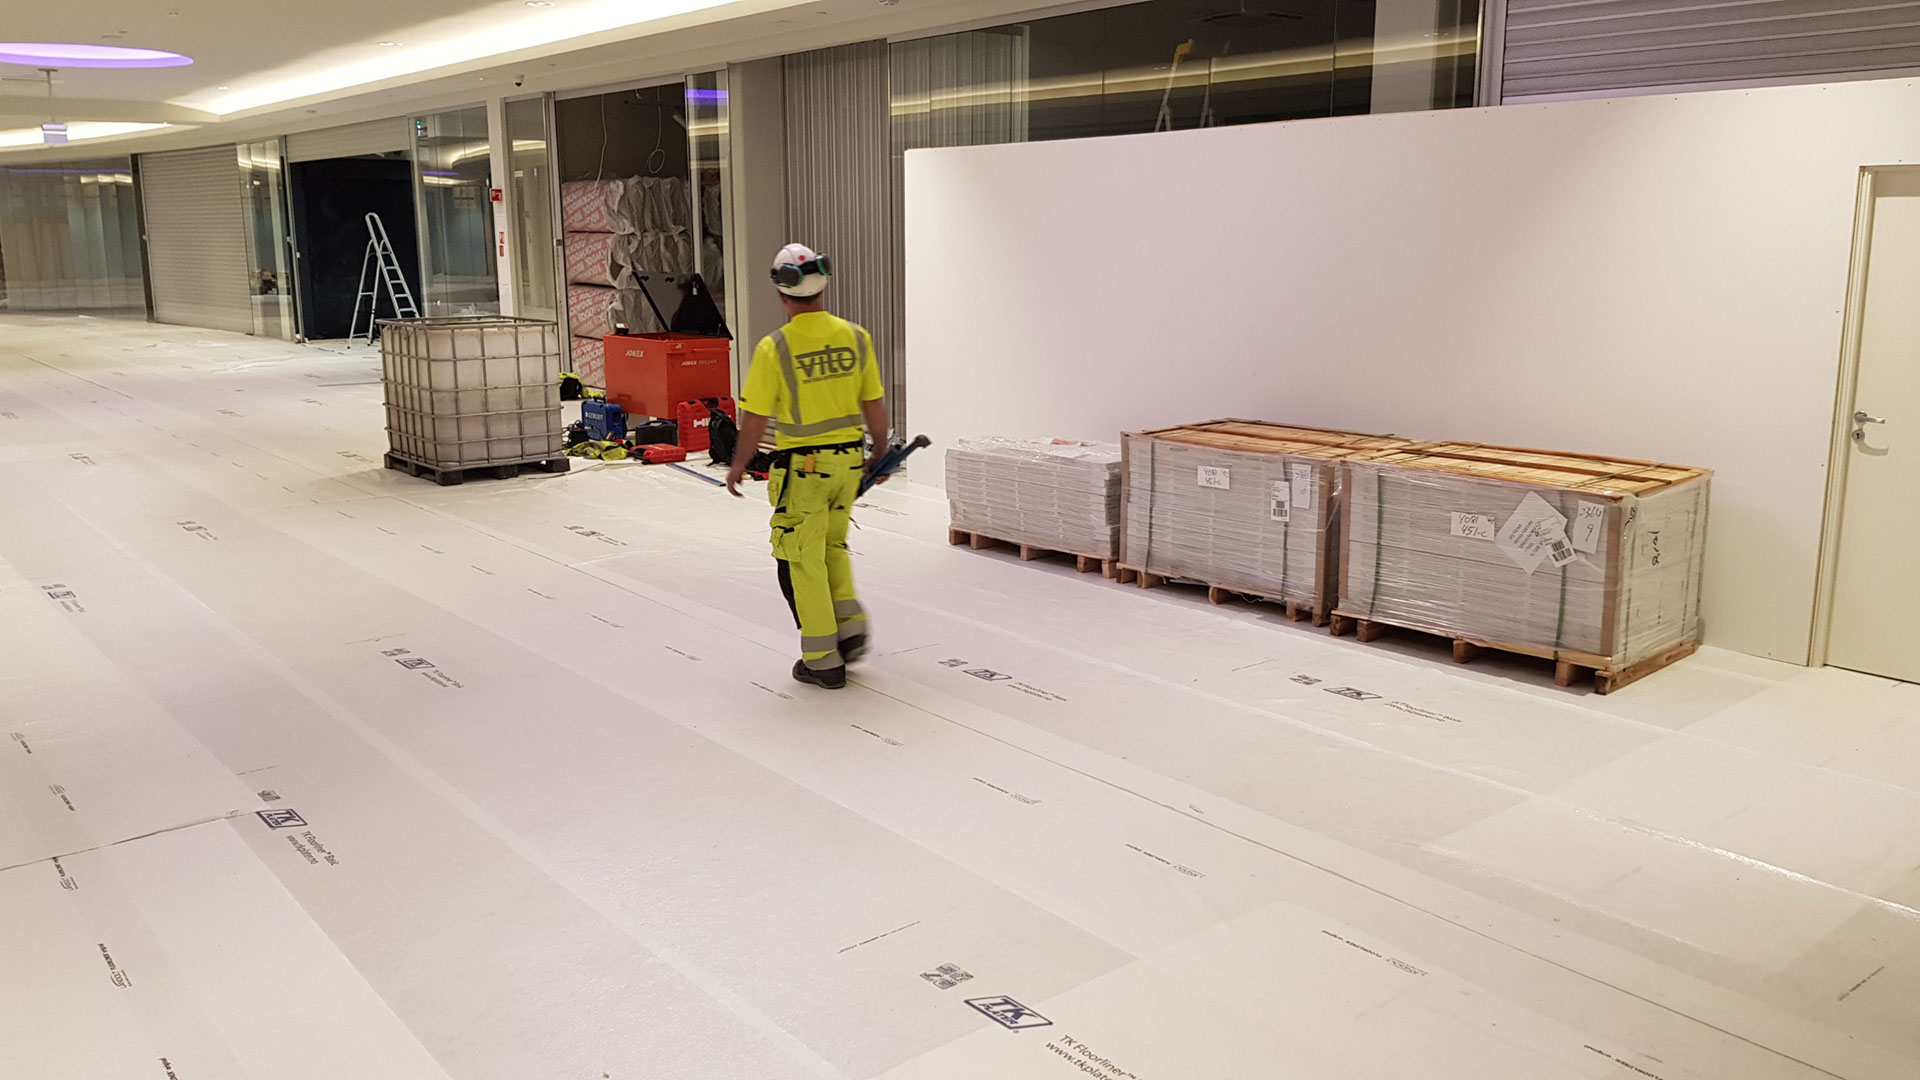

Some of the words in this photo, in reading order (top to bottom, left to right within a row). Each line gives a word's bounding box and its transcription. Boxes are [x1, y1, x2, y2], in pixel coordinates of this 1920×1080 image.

[625, 349, 644, 358] JONEX
[1585, 524, 1594, 542] 9
[978, 1003, 1019, 1025] PLATER
[989, 998, 1039, 1021] TK
[1059, 1034, 1077, 1047] TK
